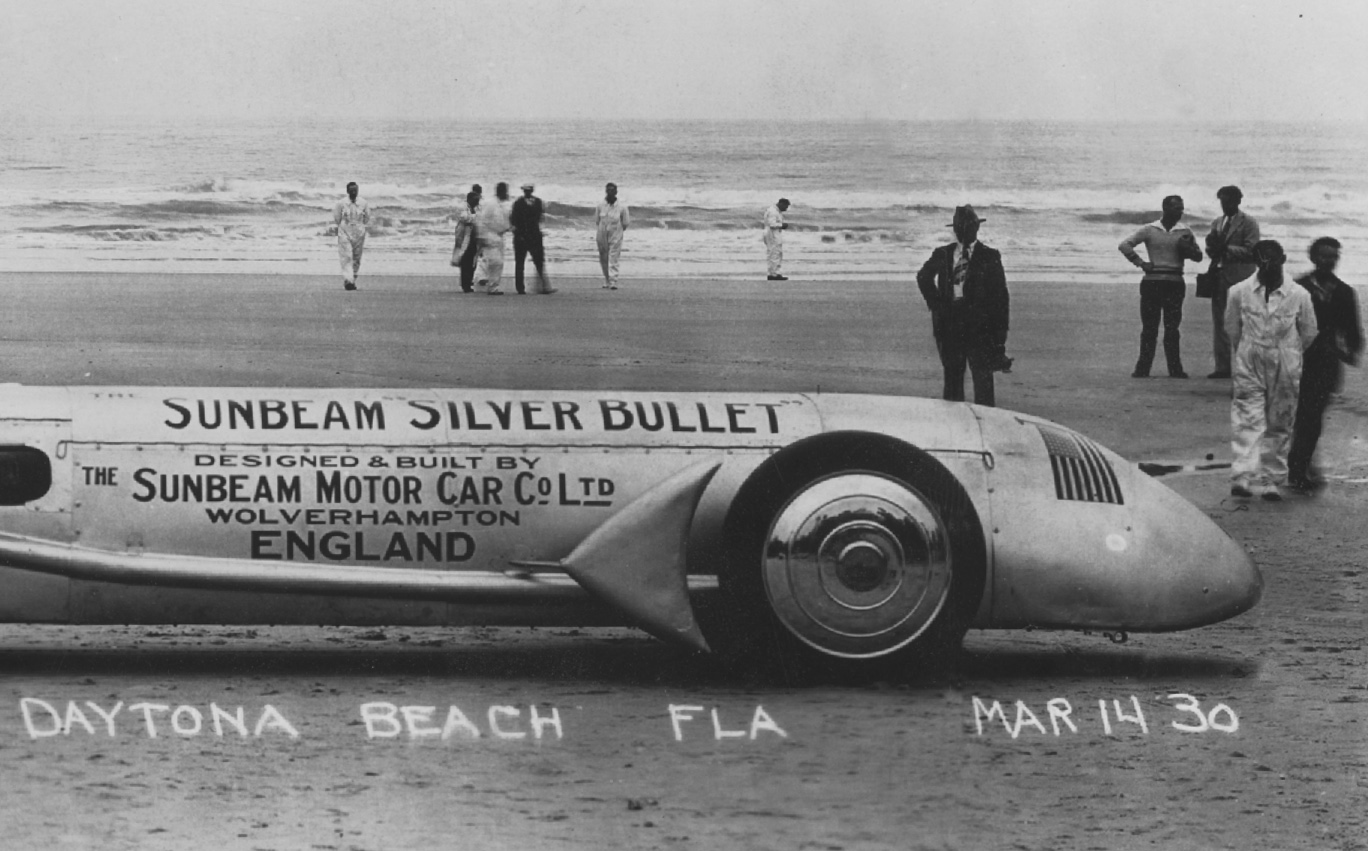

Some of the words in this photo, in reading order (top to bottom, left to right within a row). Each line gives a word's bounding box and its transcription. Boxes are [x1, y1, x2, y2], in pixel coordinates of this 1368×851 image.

[162, 398, 386, 431] SUNBEAM
[194, 453, 360, 468] DESIGNED
[367, 454, 390, 468] &
[396, 455, 484, 470] BUILT
[495, 456, 542, 470] BY
[81, 465, 119, 487] THE
[132, 467, 303, 503] SUNBEAM
[315, 469, 423, 505] MOTOR
[436, 471, 504, 506] CAR
[205, 507, 521, 527] WOLVERHAMPTON
[250, 529, 477, 563] ENGLAND
